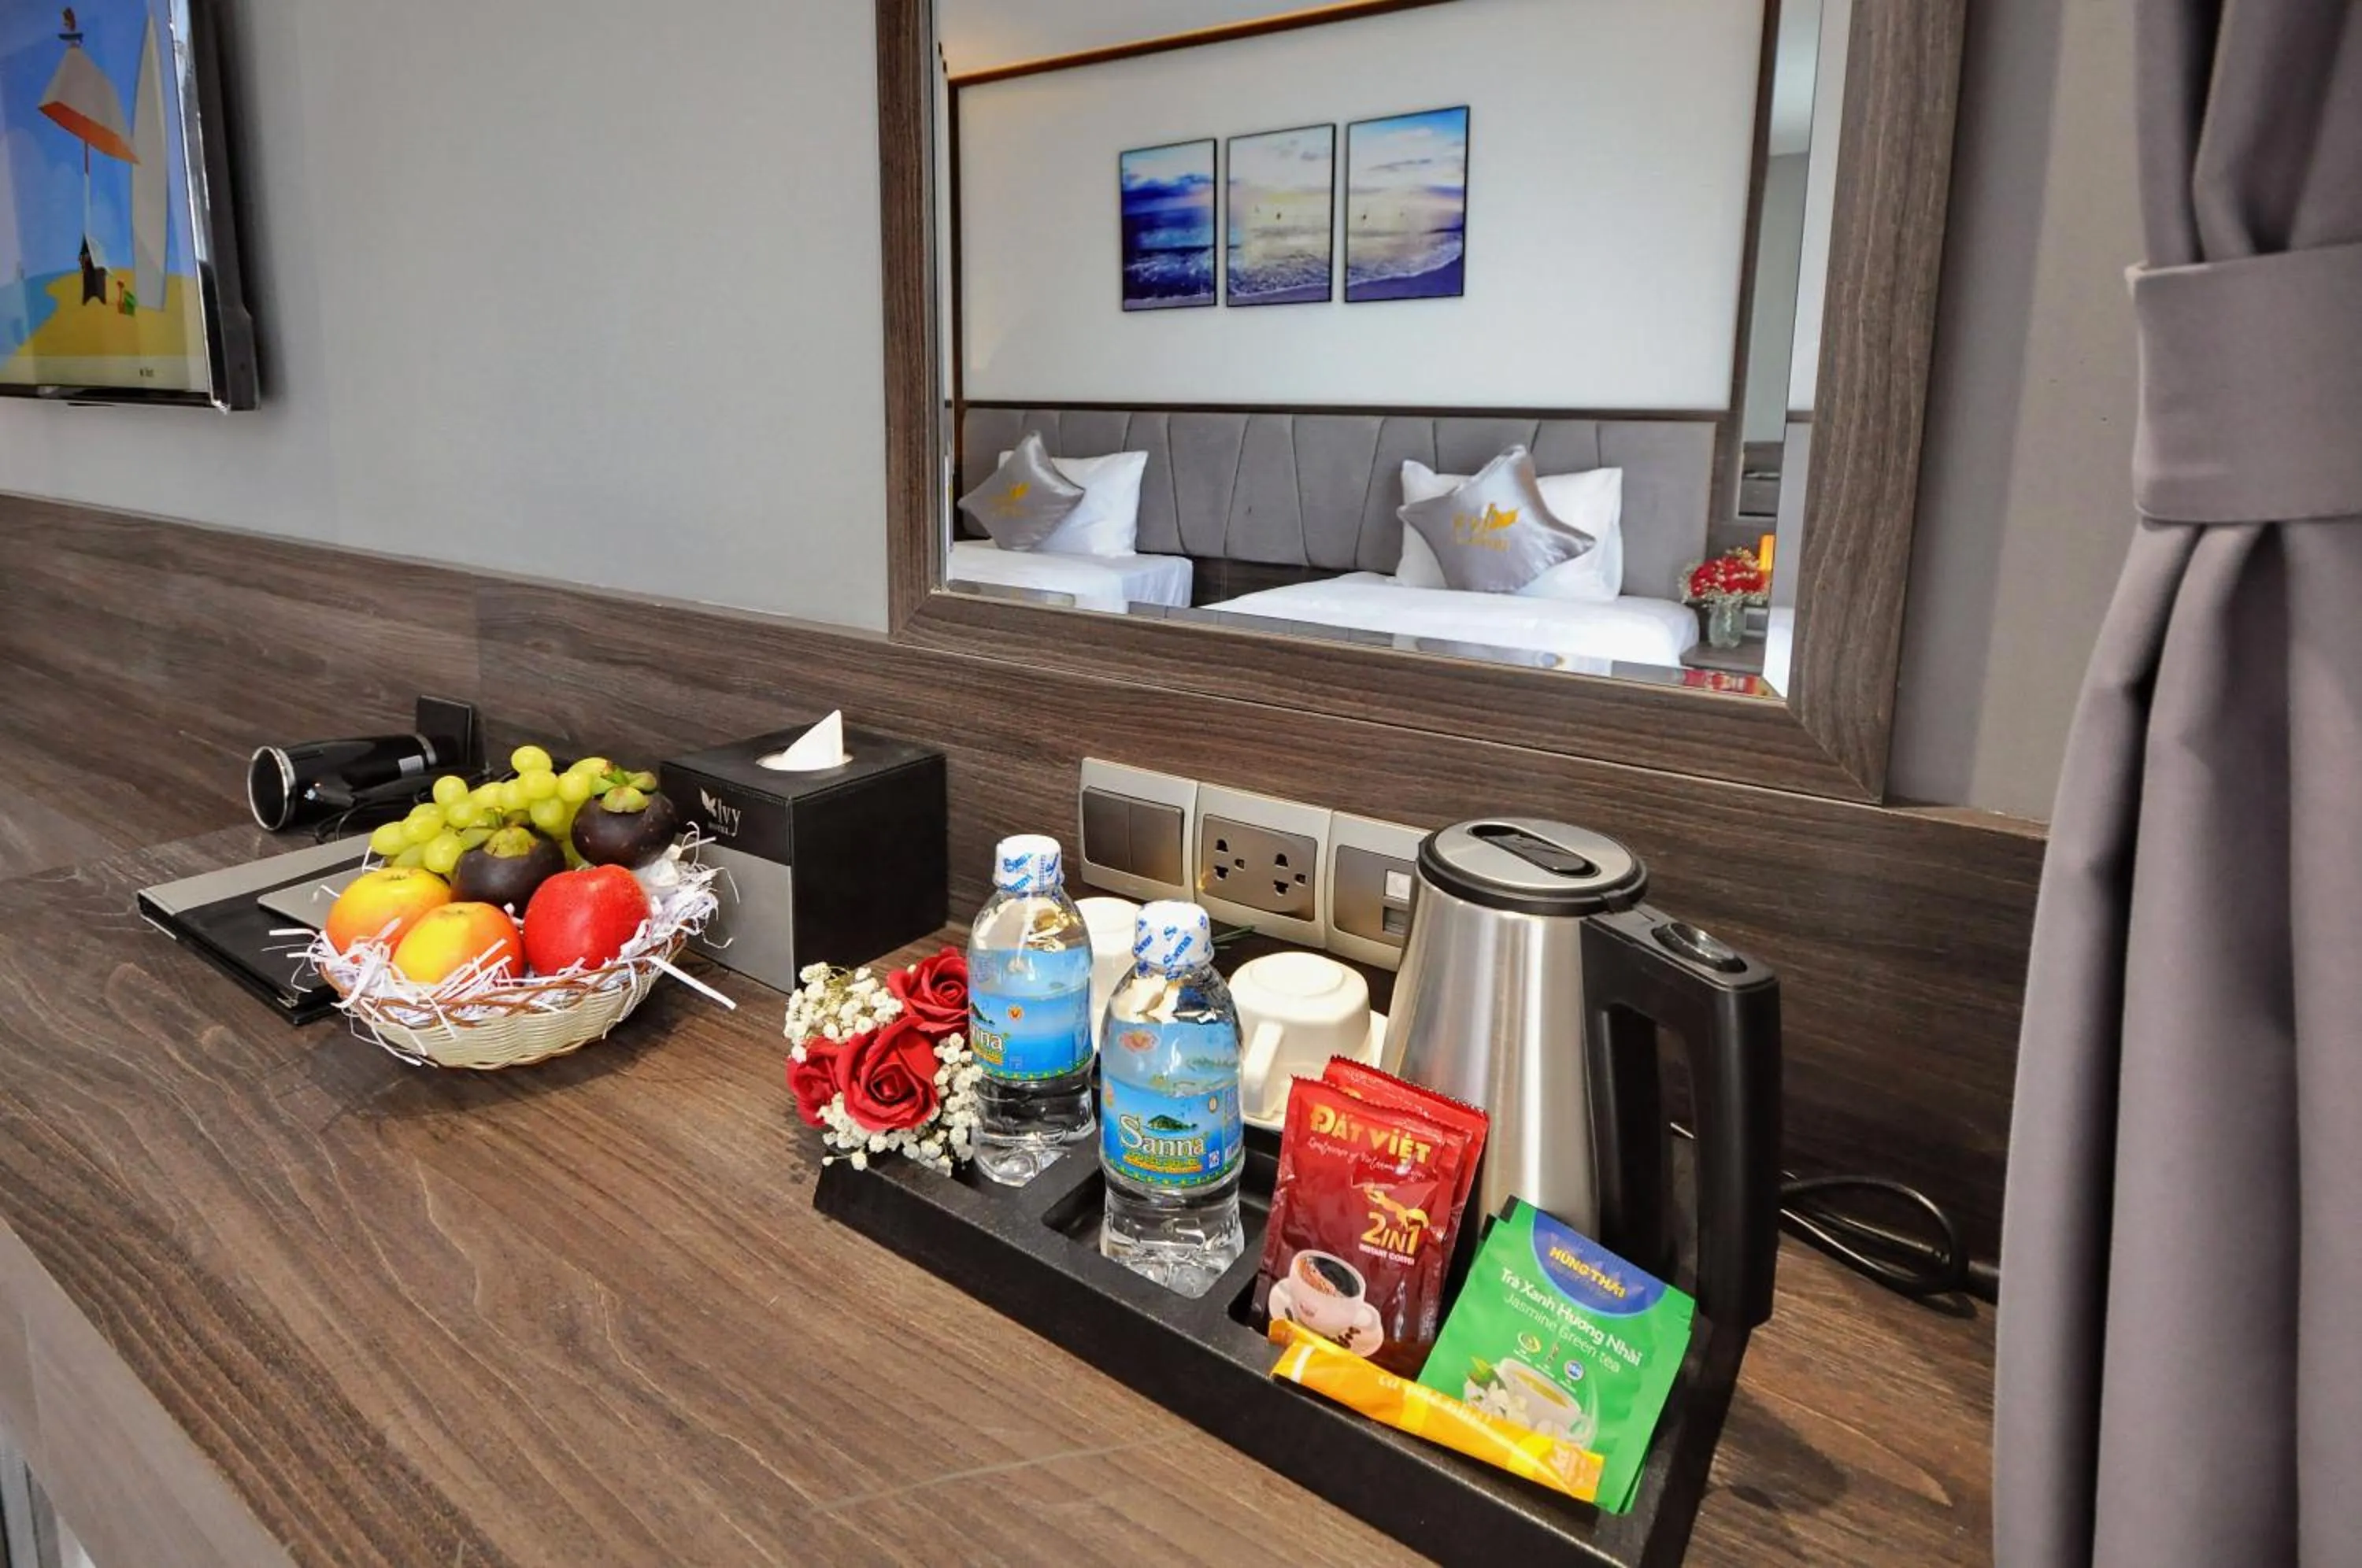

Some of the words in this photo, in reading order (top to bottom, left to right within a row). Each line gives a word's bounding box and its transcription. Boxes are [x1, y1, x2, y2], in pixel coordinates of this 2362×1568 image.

[718, 797, 742, 837] Ivy
[1120, 1114, 1205, 1156] Sanna
[1360, 1211, 1422, 1256] 2IN1
[1520, 1280, 1557, 1312] Xanh
[1504, 1292, 1557, 1333] Jasmine
[1558, 1324, 1597, 1358] Green
[1599, 1351, 1621, 1374] tea
